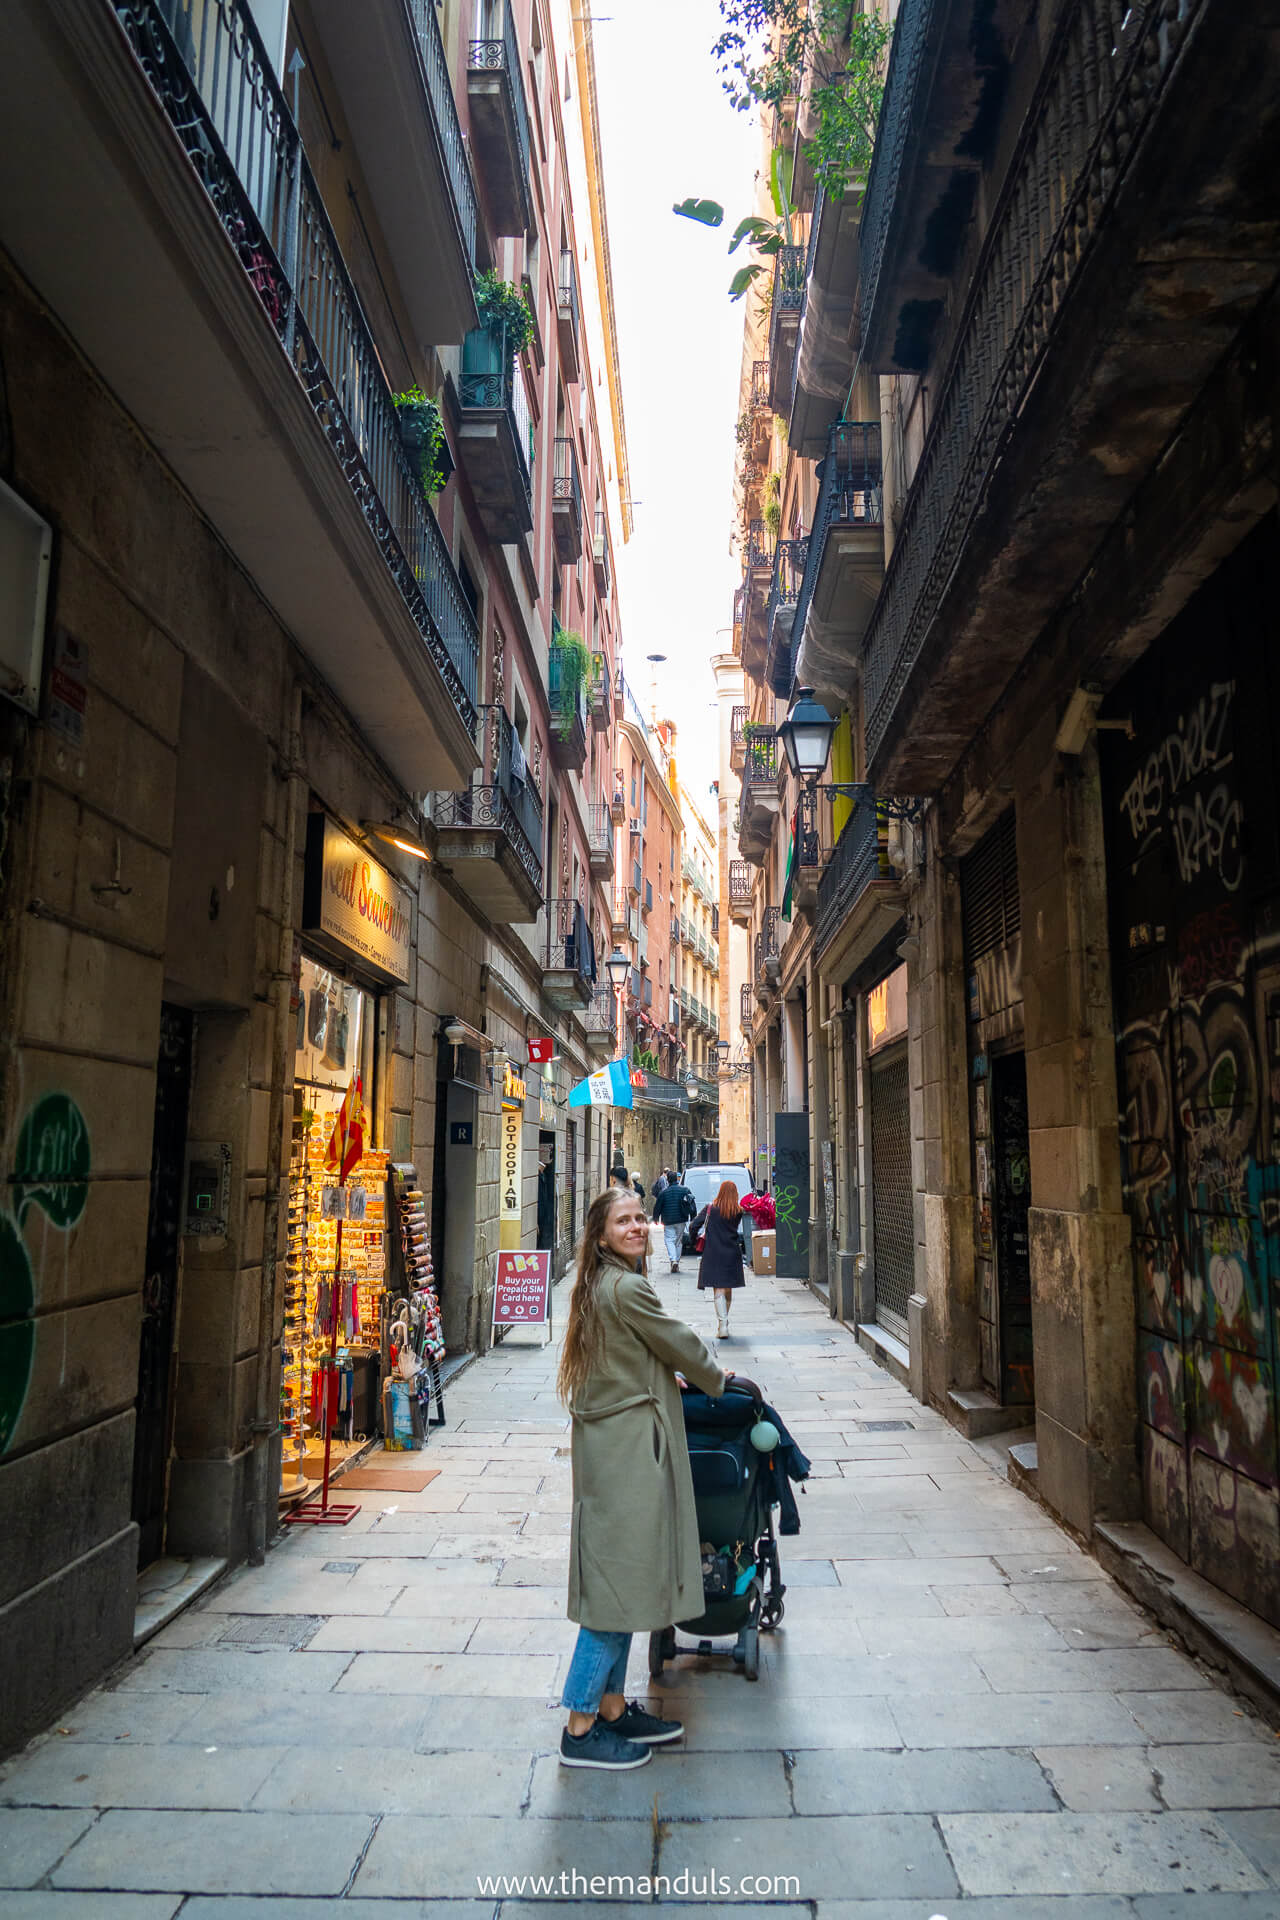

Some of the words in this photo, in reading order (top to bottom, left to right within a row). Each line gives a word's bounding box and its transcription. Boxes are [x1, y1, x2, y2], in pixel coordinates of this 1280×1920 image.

[458, 1127, 466, 1140] R
[505, 1116, 517, 1195] FOTOCOPIA
[505, 1276, 521, 1286] Buy
[521, 1278, 540, 1286] your
[498, 1285, 528, 1295] Prepaid
[529, 1285, 544, 1293] SIM
[502, 1294, 521, 1302] Card
[522, 1294, 540, 1302] here
